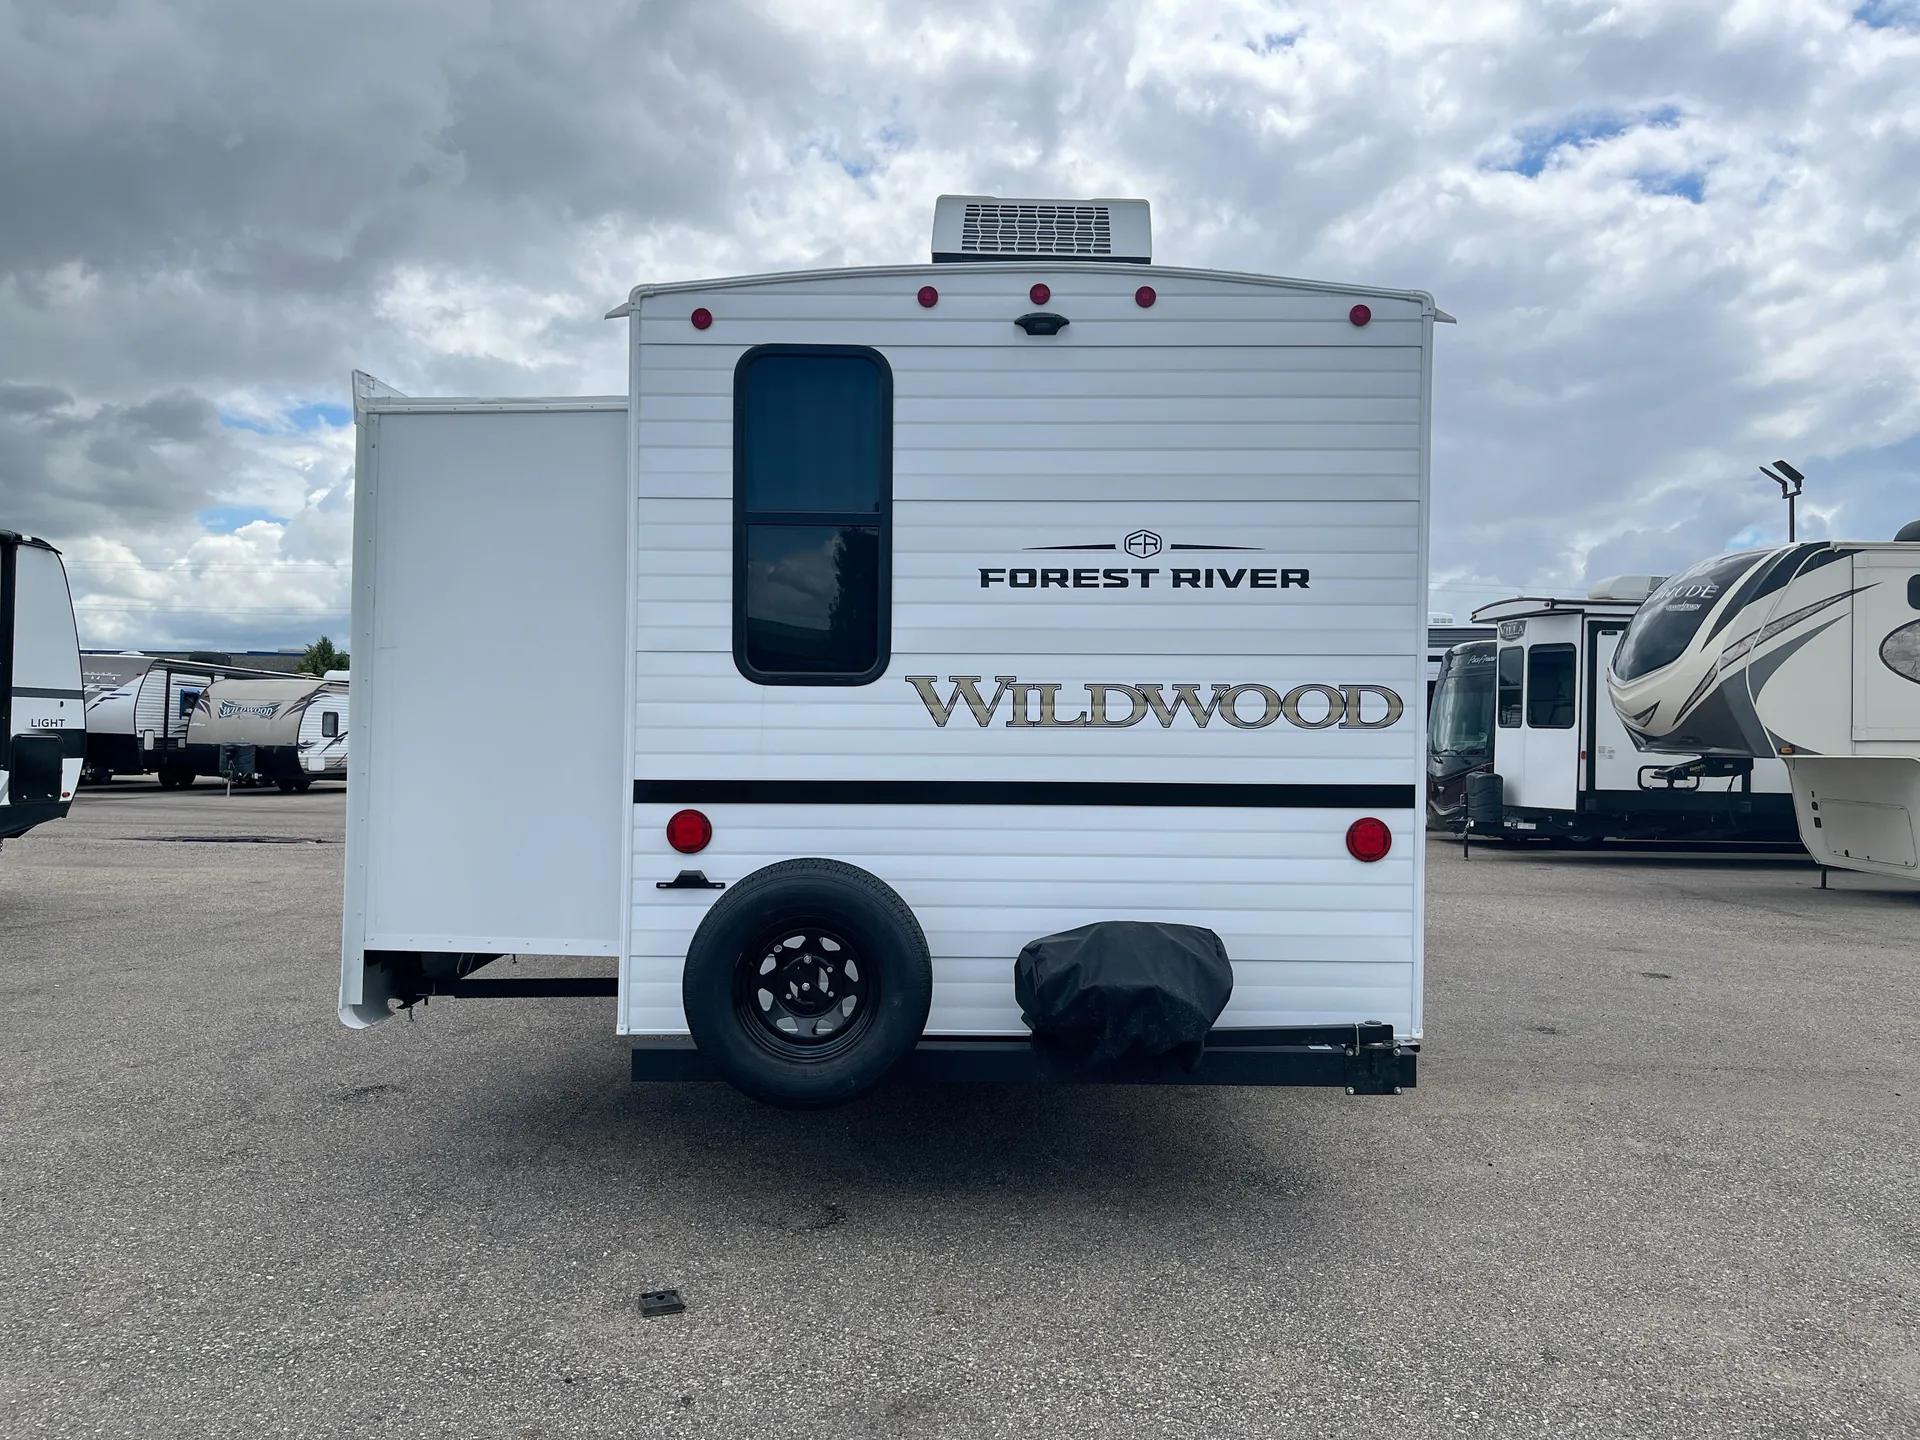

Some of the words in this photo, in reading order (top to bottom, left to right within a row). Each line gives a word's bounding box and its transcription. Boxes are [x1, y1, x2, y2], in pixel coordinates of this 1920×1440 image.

[978, 568, 1160, 589] FOREST
[1170, 568, 1310, 589] RIVER
[1499, 624, 1524, 636] VILLA
[905, 676, 1404, 730] WILDWOOD
[223, 705, 273, 716] WILDWOOD
[31, 718, 66, 728] LIGHT
